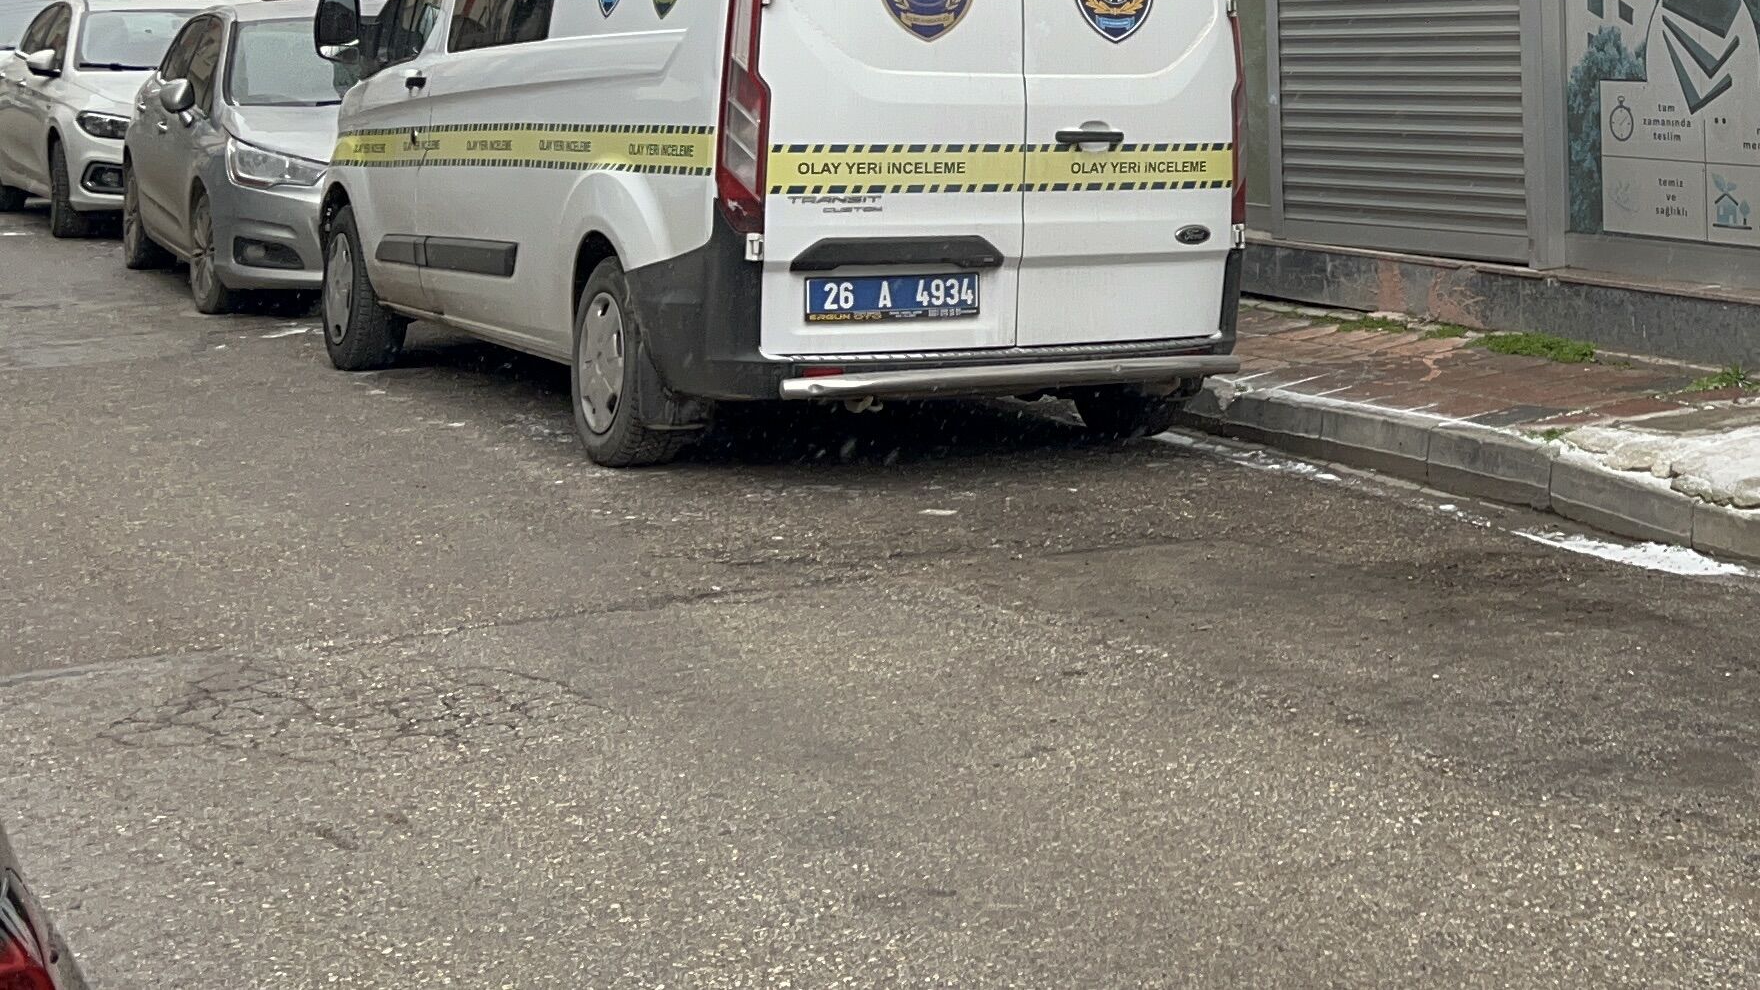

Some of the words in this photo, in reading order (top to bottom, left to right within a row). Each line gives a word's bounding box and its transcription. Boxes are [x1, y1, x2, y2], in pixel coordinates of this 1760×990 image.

[1643, 117, 1692, 128] zamanında
[1653, 132, 1682, 142] teslim
[628, 143, 645, 156] OLAY
[797, 162, 842, 175] OLAY
[1071, 162, 1107, 174] OLAY
[1658, 178, 1684, 188] temiz
[1666, 193, 1677, 202] ve
[824, 282, 854, 310] 26
[878, 280, 892, 308] A
[916, 278, 974, 307] 4934
